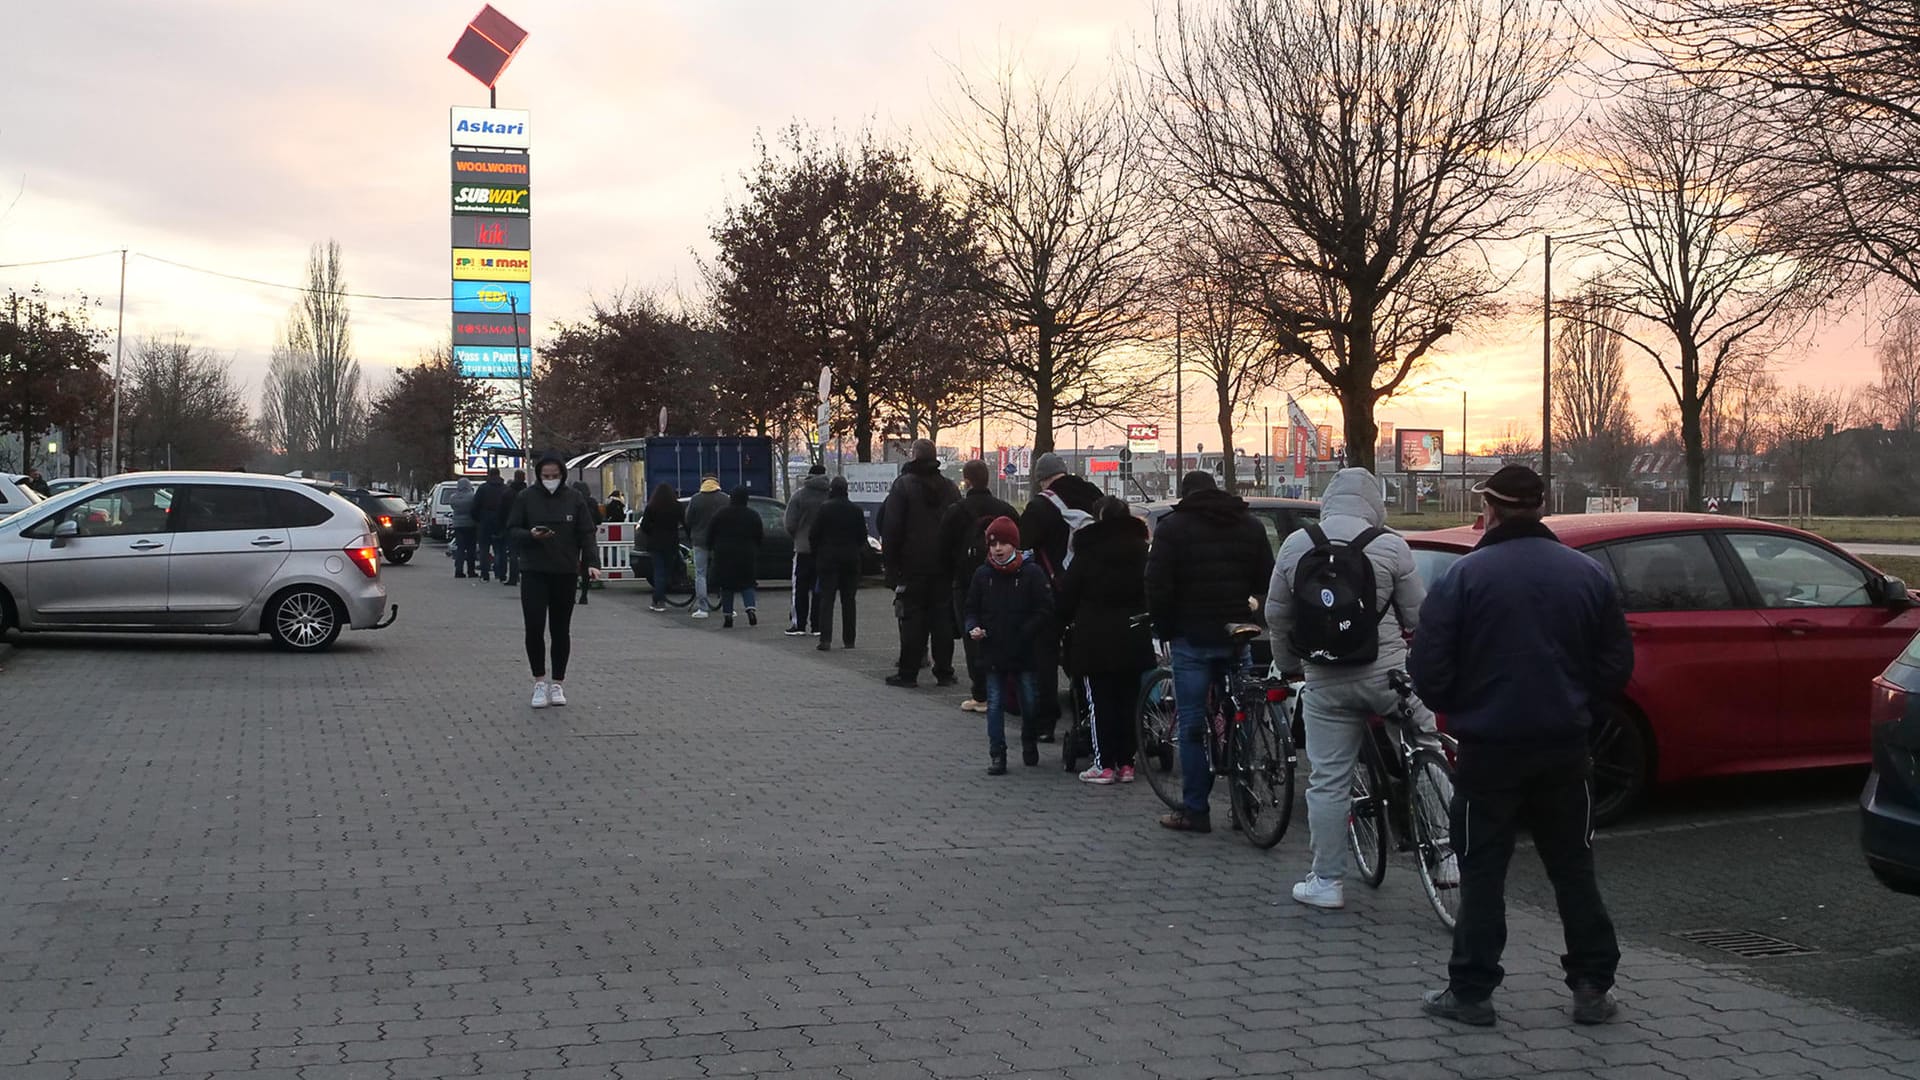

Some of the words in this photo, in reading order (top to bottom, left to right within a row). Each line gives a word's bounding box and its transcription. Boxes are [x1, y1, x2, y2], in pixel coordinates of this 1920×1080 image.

[456, 119, 524, 135] Askari
[456, 161, 527, 174] WOOLWORTH
[454, 187, 528, 205] SUBWAY
[455, 257, 493, 267] SPILE
[495, 258, 529, 268] MAX
[1130, 427, 1156, 437] KFC
[471, 456, 514, 469] ALDI
[1339, 620, 1351, 631] NP
